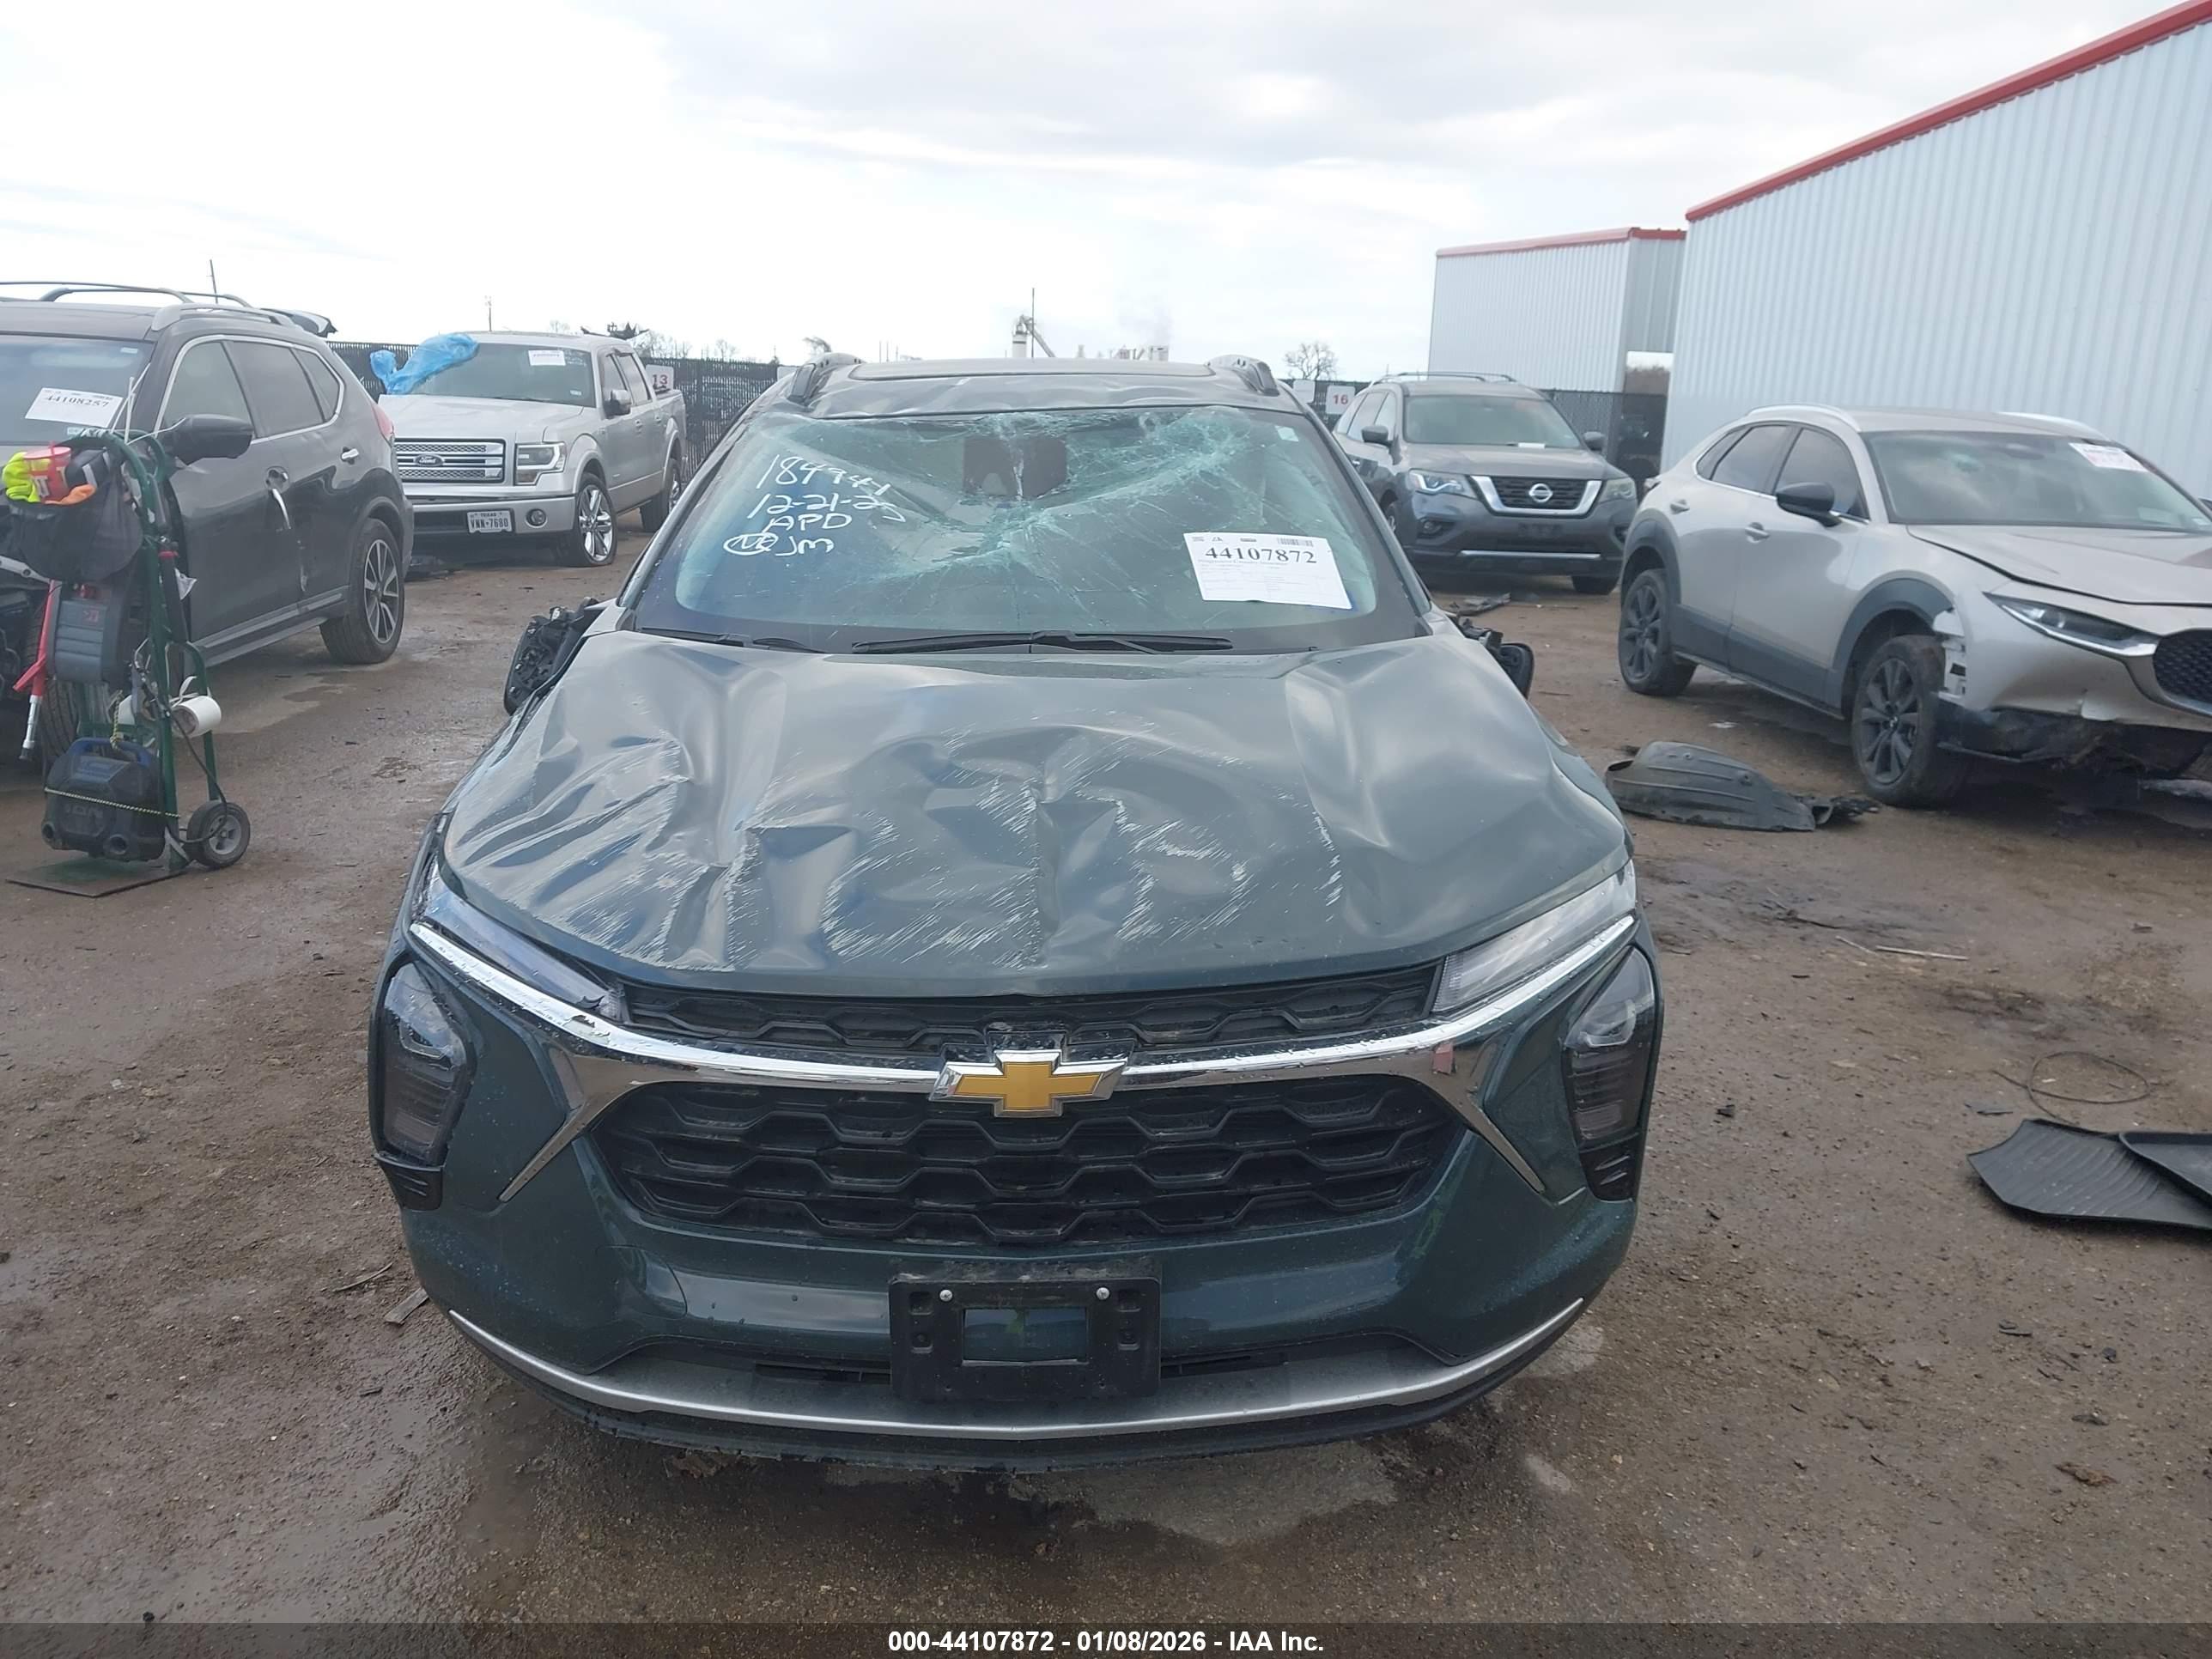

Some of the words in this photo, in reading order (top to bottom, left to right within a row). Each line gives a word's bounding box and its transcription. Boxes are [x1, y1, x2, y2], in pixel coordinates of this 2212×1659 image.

[653, 374, 668, 386] 13
[1333, 394, 1349, 404] 16
[762, 513, 853, 533] APD
[1205, 547, 1317, 564] 44107872
